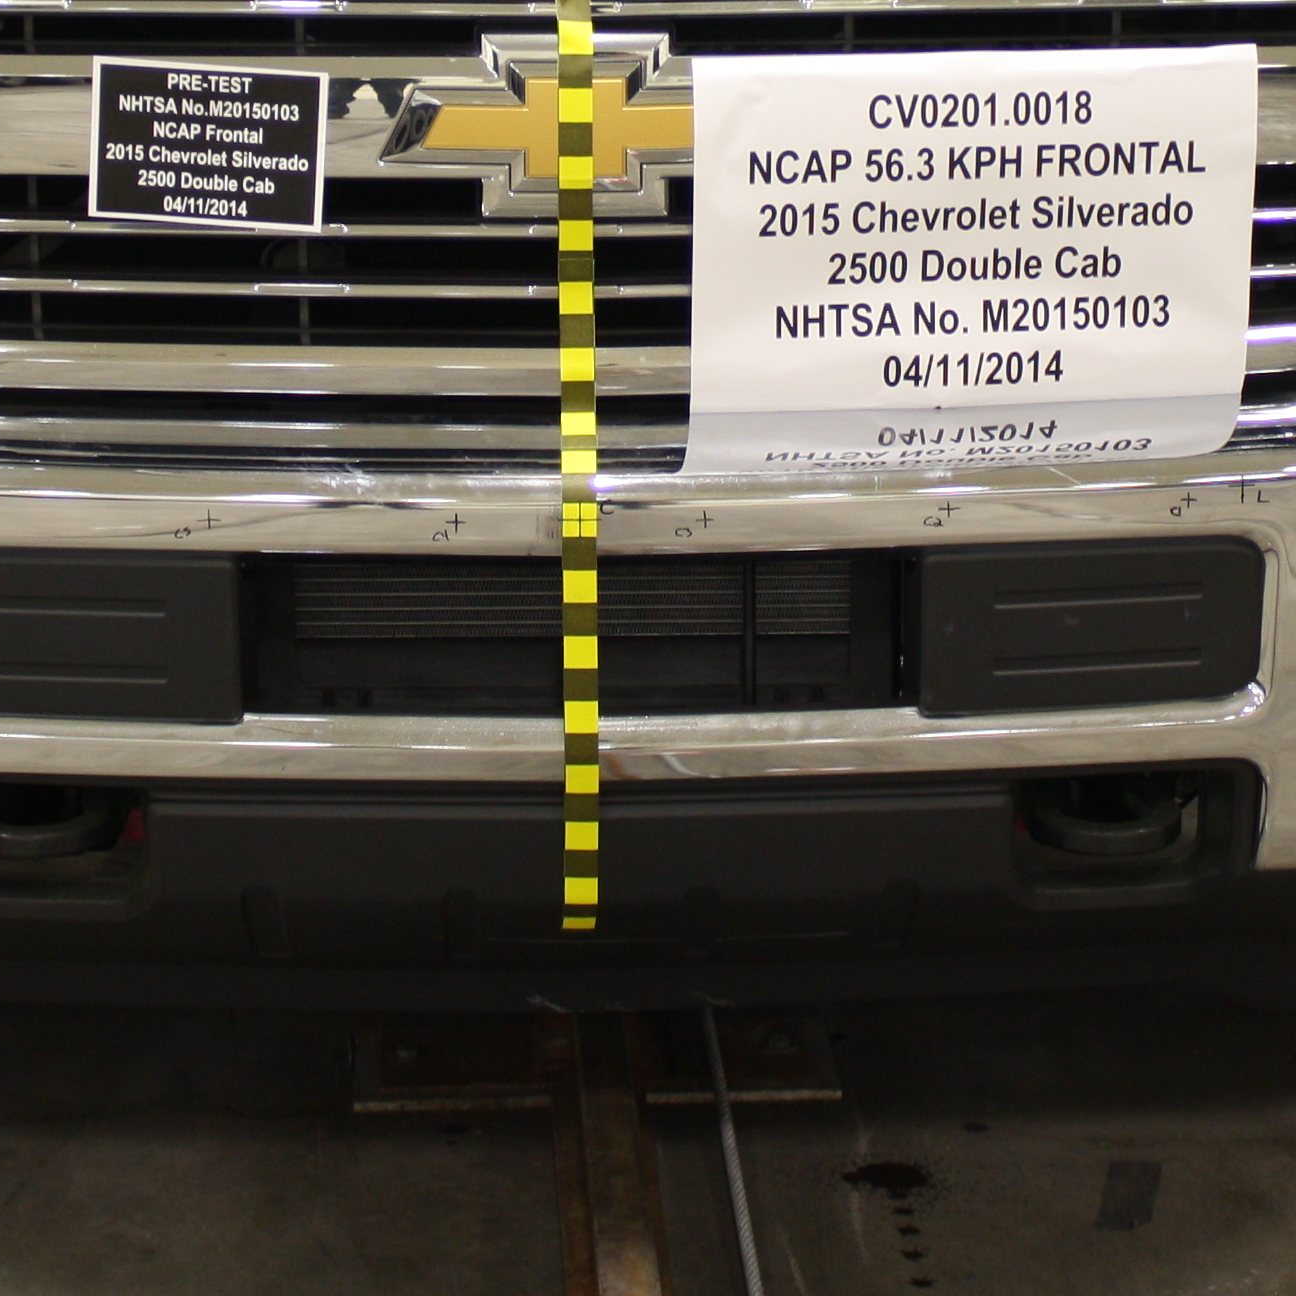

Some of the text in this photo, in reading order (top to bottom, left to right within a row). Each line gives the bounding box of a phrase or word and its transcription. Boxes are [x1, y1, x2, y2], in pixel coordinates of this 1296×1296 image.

[167, 73, 253, 94] PRE-TEST
[119, 95, 299, 121] NHTSA No.M20150103
[870, 91, 1091, 129] CV0201.0018
[154, 121, 263, 144] NCAP Frontal
[106, 143, 308, 171] 2015 Chevrolet Silverado
[750, 141, 1205, 184] NCAP 56.3 KPH FRONTAL
[138, 169, 274, 194] 2500 Double Cab
[162, 196, 248, 218] 04/11/2014
[759, 193, 1193, 237] 2015 Chevrolet Silverado
[828, 246, 1121, 284] 2500 Double Cab
[777, 295, 1169, 338] NHTSA No. M20150103
[884, 350, 1063, 387] 04/11/2014
[923, 516, 944, 528] C2
